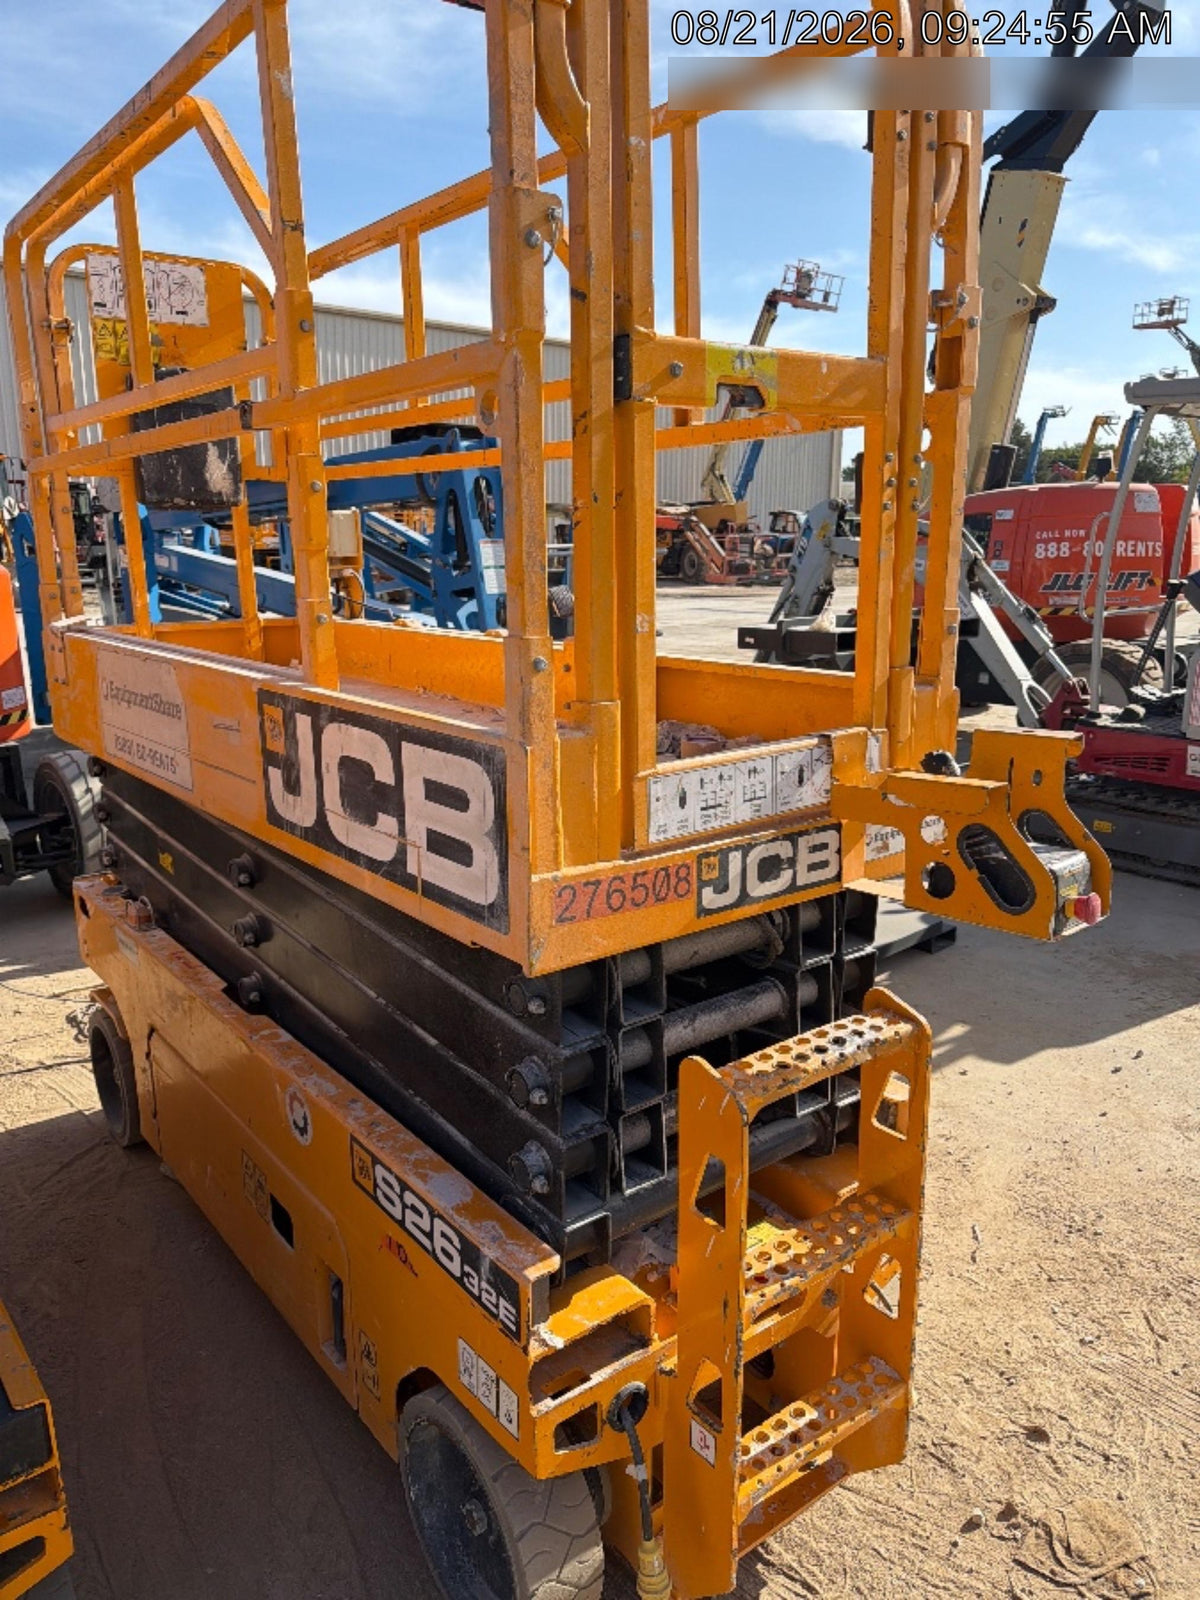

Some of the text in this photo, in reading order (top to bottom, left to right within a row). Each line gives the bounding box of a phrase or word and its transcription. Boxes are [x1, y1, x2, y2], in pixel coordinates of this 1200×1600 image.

[1036, 529, 1086, 539] CALL NOW
[267, 713, 499, 906] JCB
[555, 862, 692, 924] 276508
[700, 829, 840, 910] JCB
